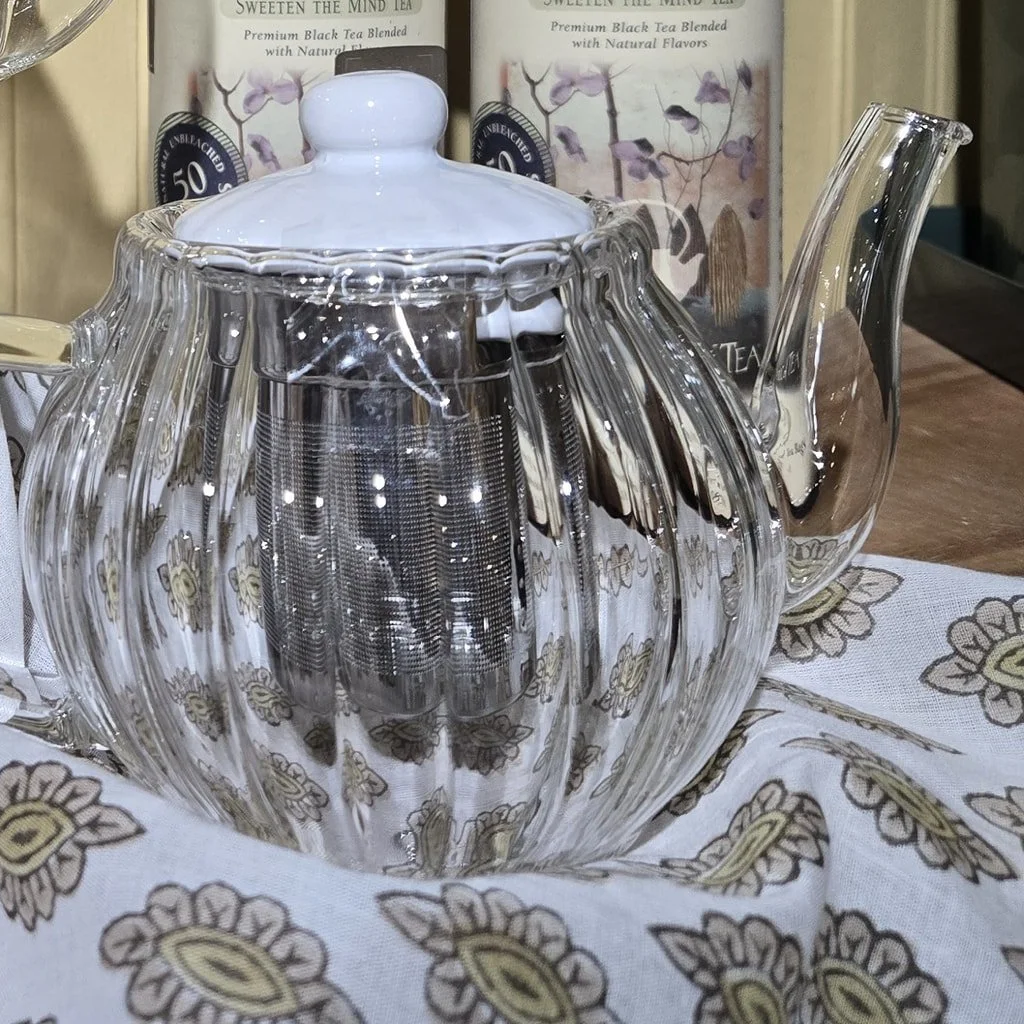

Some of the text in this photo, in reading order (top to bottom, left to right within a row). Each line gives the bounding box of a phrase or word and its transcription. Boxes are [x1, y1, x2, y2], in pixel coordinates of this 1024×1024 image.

[244, 25, 407, 41] Premium Black Tea Blended
[550, 19, 727, 33] Premium Black Tea Blended
[265, 45, 292, 56] with
[297, 44, 345, 57] Natural
[572, 37, 708, 49] with Natural Flavors
[169, 133, 225, 173] UNBLEACHED
[173, 161, 207, 200] 50
[719, 342, 761, 373] TEA
